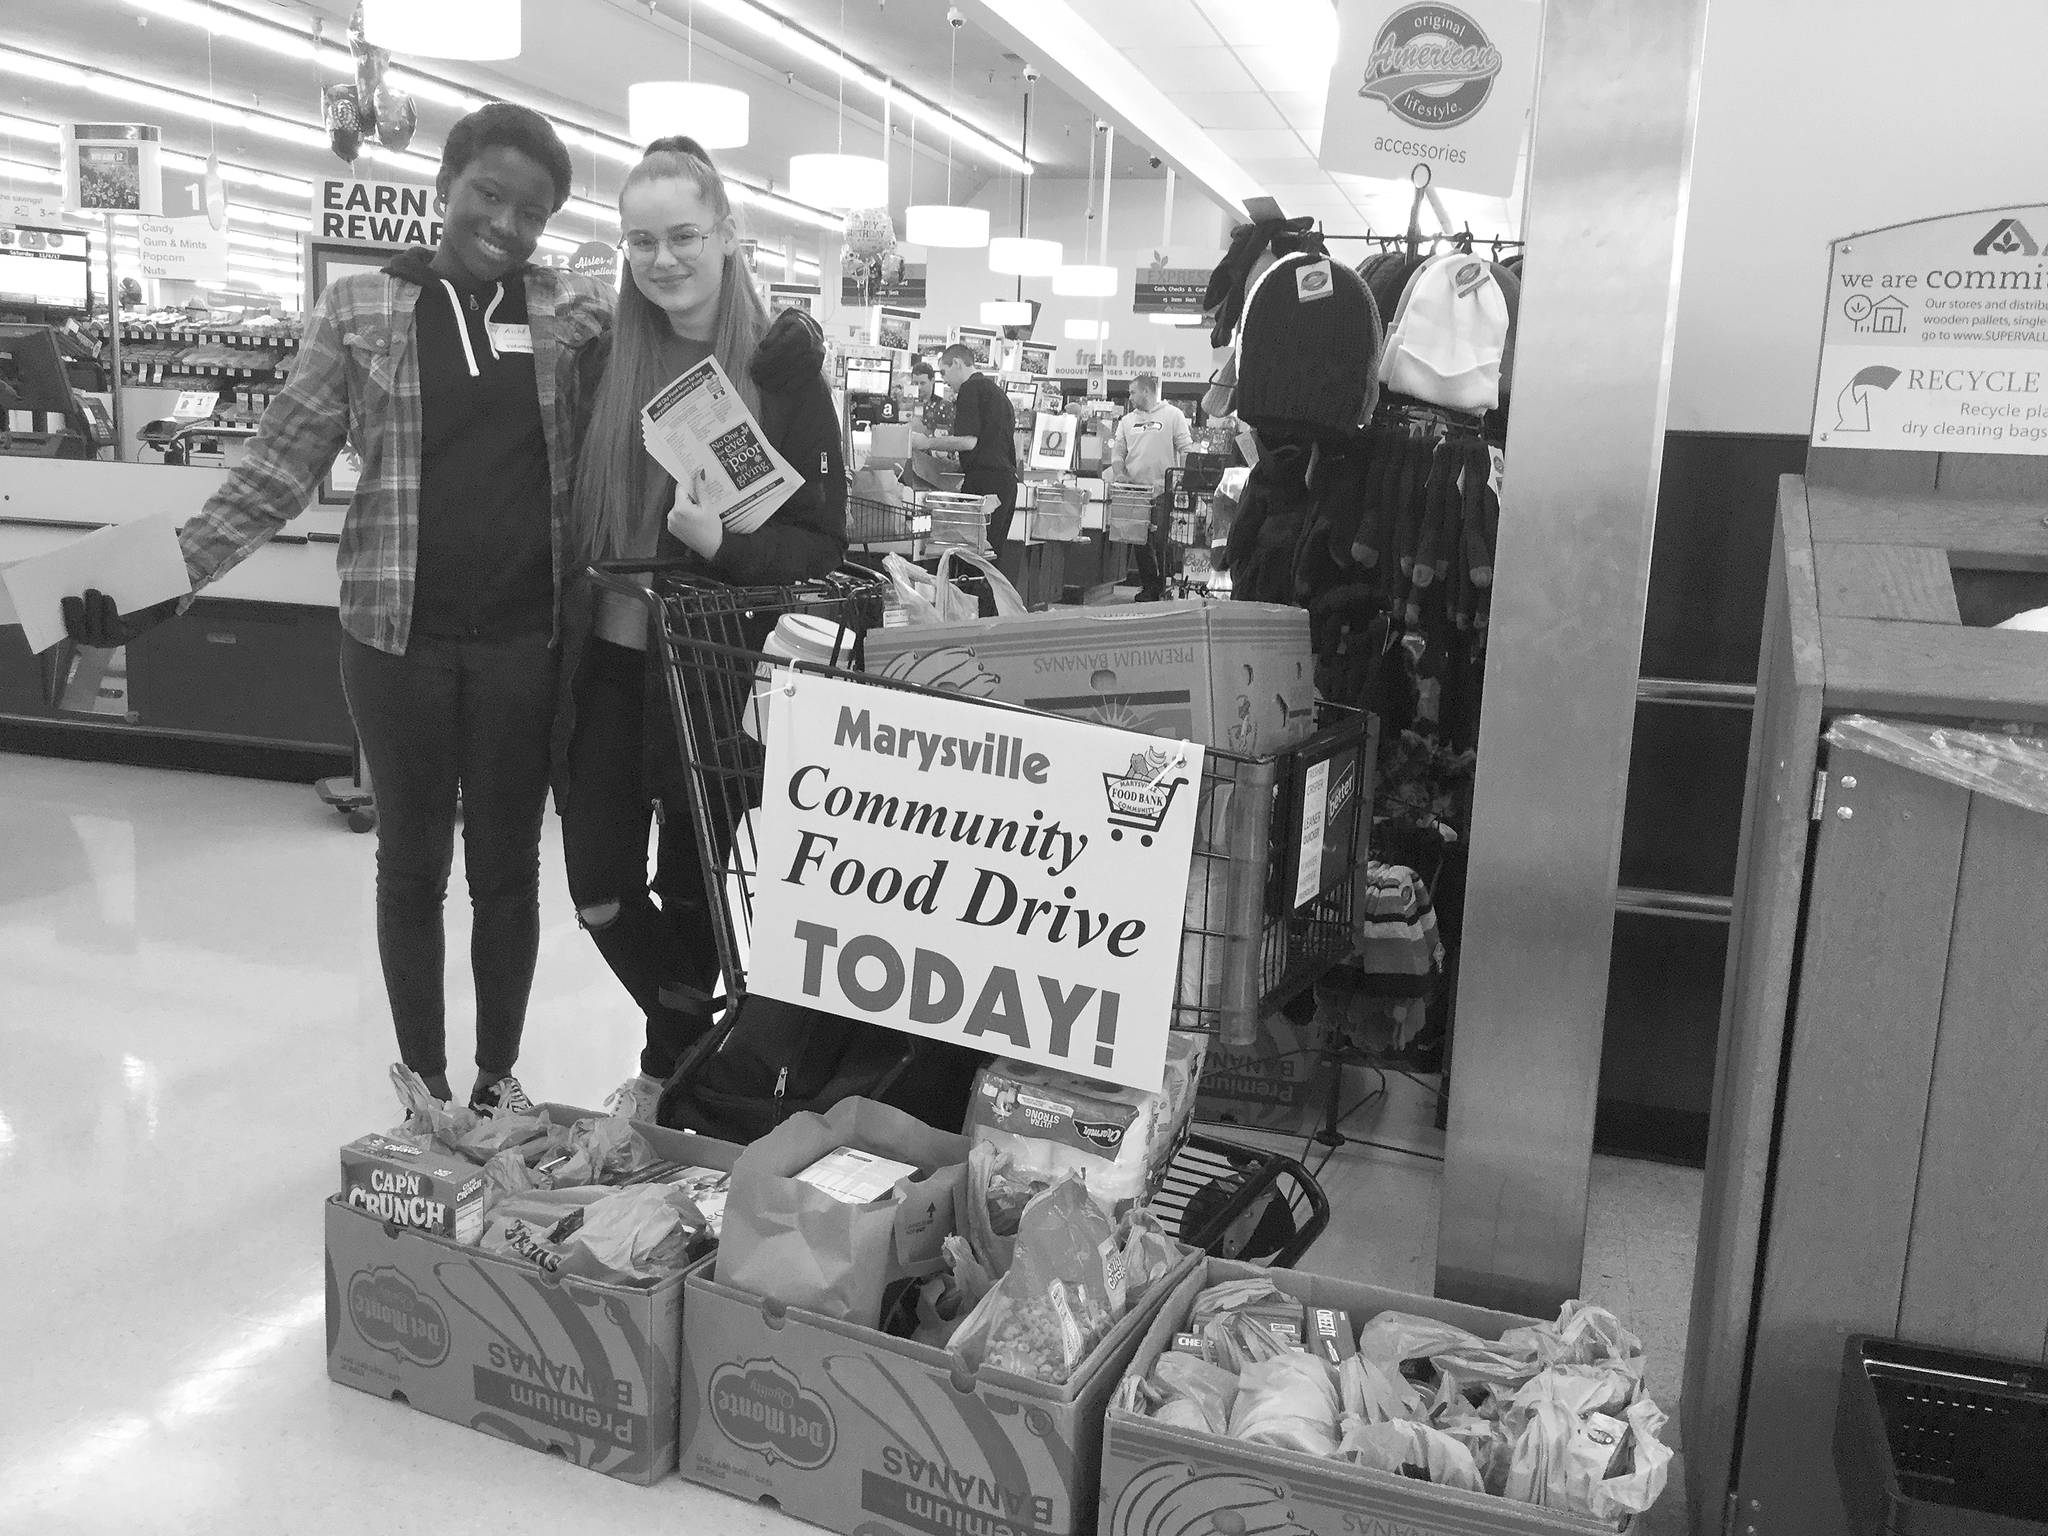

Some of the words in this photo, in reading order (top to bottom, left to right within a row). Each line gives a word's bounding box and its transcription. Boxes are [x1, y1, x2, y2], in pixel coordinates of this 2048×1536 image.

[1414, 14, 1466, 37] original
[1365, 31, 1502, 81] American
[1404, 94, 1459, 121] lifestyle
[1374, 136, 1467, 164] accessories
[184, 182, 200, 211] 1
[323, 180, 427, 217] EARN
[142, 223, 174, 235] Candy
[323, 211, 443, 246] REWAR
[144, 238, 167, 248] Gum
[170, 239, 177, 247] &
[179, 240, 207, 250] Mints
[143, 253, 185, 263] Popcorn
[143, 266, 166, 275] Nuts
[542, 254, 570, 269] 12
[1841, 273, 1873, 288] we
[1881, 273, 1918, 288] are
[1925, 299, 1946, 310] Our
[1949, 299, 1983, 310] stores
[1985, 298, 2010, 310] and
[1924, 314, 1969, 326] wooden
[1971, 315, 2011, 329] pallets,
[1921, 331, 1937, 342] go
[1938, 330, 1951, 340] to
[1055, 368, 1089, 376] BOUQUET
[1907, 368, 2041, 393] RECYCLE
[1092, 380, 1099, 390] 9
[1960, 402, 2021, 420] Recycle
[711, 440, 724, 451] No
[723, 431, 739, 443] One
[1902, 420, 1928, 438] dry
[1933, 421, 2002, 440] cleaning
[724, 435, 747, 453] ever
[729, 442, 761, 473] poor
[737, 461, 770, 487] giving
[1033, 653, 1109, 674] BANANAS
[1114, 647, 1195, 667] PREMIUM
[833, 705, 1051, 785] Marysville
[1112, 788, 1137, 801] FOOD
[1138, 793, 1163, 807] BANK
[1120, 781, 1157, 794] MARYSVILE
[1329, 775, 1354, 817] better
[1118, 801, 1155, 814] COMMUNITY
[787, 764, 1088, 877] Community
[781, 829, 949, 916] Food
[956, 866, 1146, 958] Drive
[794, 919, 1120, 1068] TODAY!
[1024, 1107, 1062, 1127] STRONG
[1029, 1116, 1053, 1130] ULTRA
[1078, 1122, 1122, 1147] Charmin
[371, 1168, 421, 1196] CAP'N
[349, 1187, 446, 1229] CRUNCH
[356, 1289, 414, 1337] Monte
[413, 1315, 442, 1347] Del
[488, 1341, 634, 1399] BNANAS
[509, 1383, 634, 1444] Premium
[718, 1390, 785, 1434] Monte
[786, 1408, 826, 1442] Del
[882, 1445, 1053, 1525] BANANAS
[904, 1486, 1020, 1536] emium
